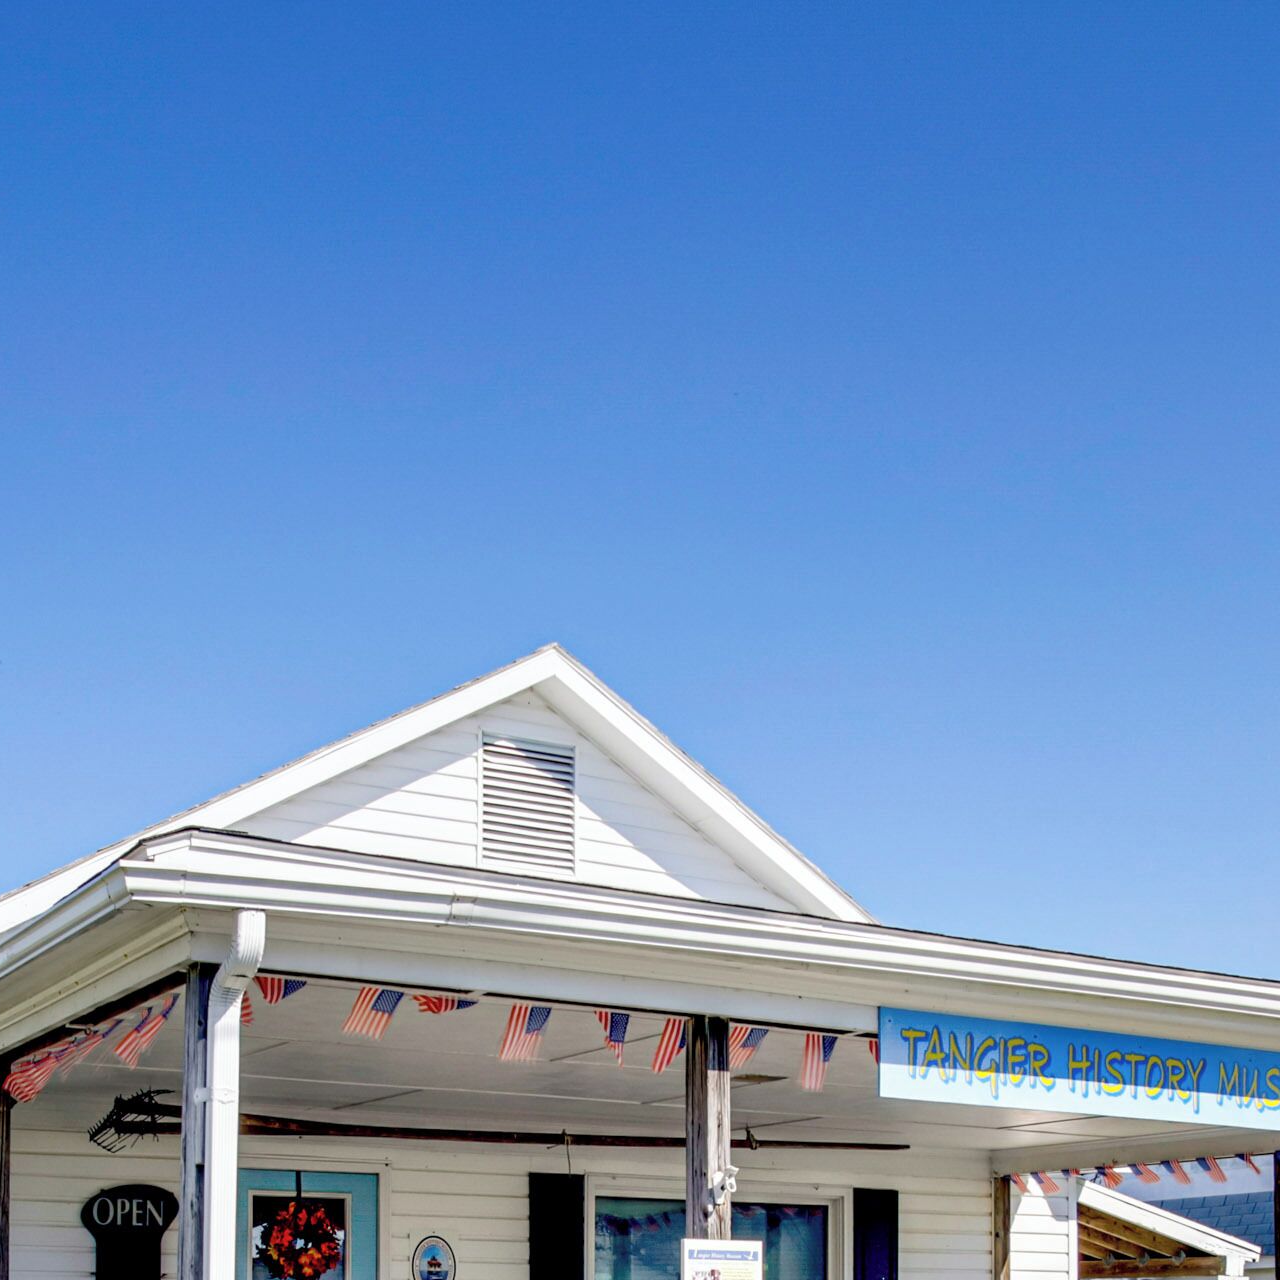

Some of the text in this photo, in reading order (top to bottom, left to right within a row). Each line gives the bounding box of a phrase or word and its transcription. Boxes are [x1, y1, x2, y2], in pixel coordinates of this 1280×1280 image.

[900, 1026, 1055, 1098] TANGIER
[1068, 1043, 1205, 1113] HISTORY
[92, 1197, 164, 1227] OPEN
